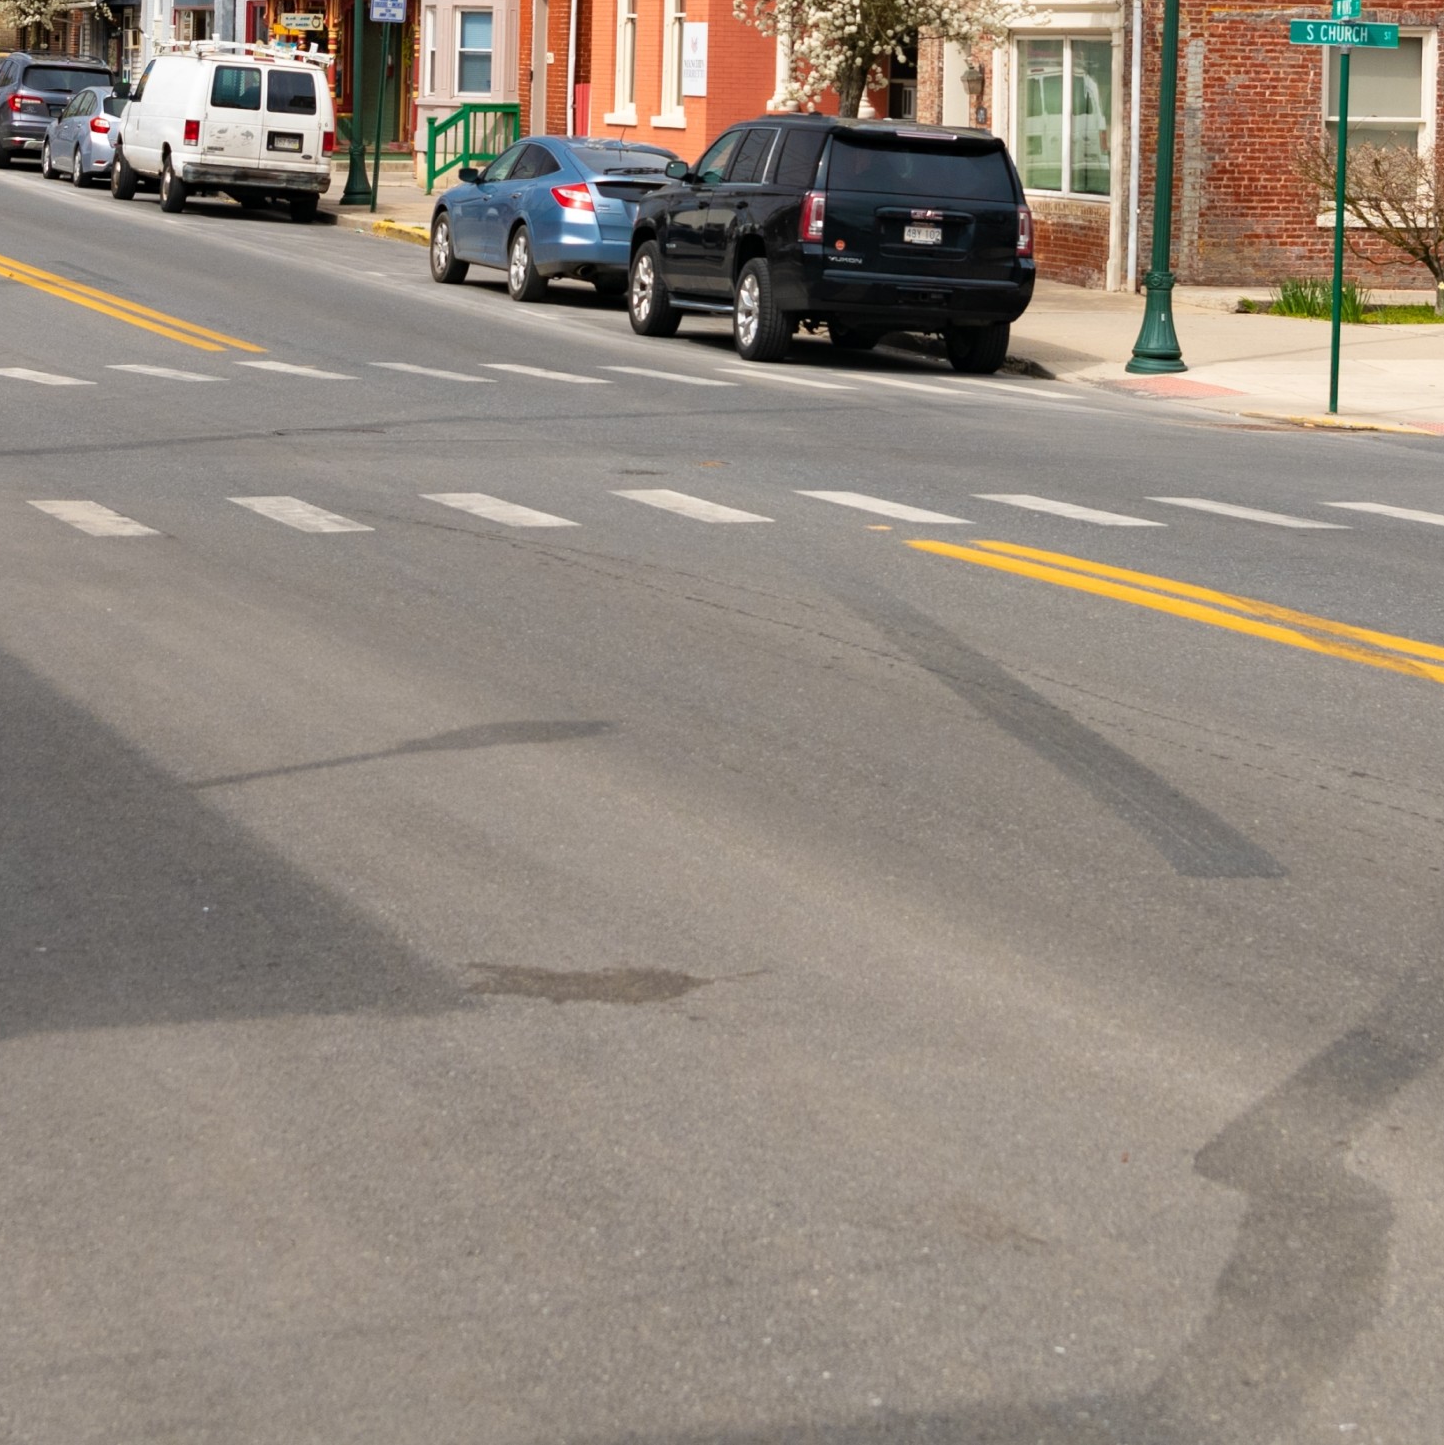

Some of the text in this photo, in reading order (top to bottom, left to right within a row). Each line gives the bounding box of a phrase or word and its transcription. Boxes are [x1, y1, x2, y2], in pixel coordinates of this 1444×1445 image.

[1306, 24, 1392, 43] S CHURCH ST
[828, 256, 863, 264] YUKON
